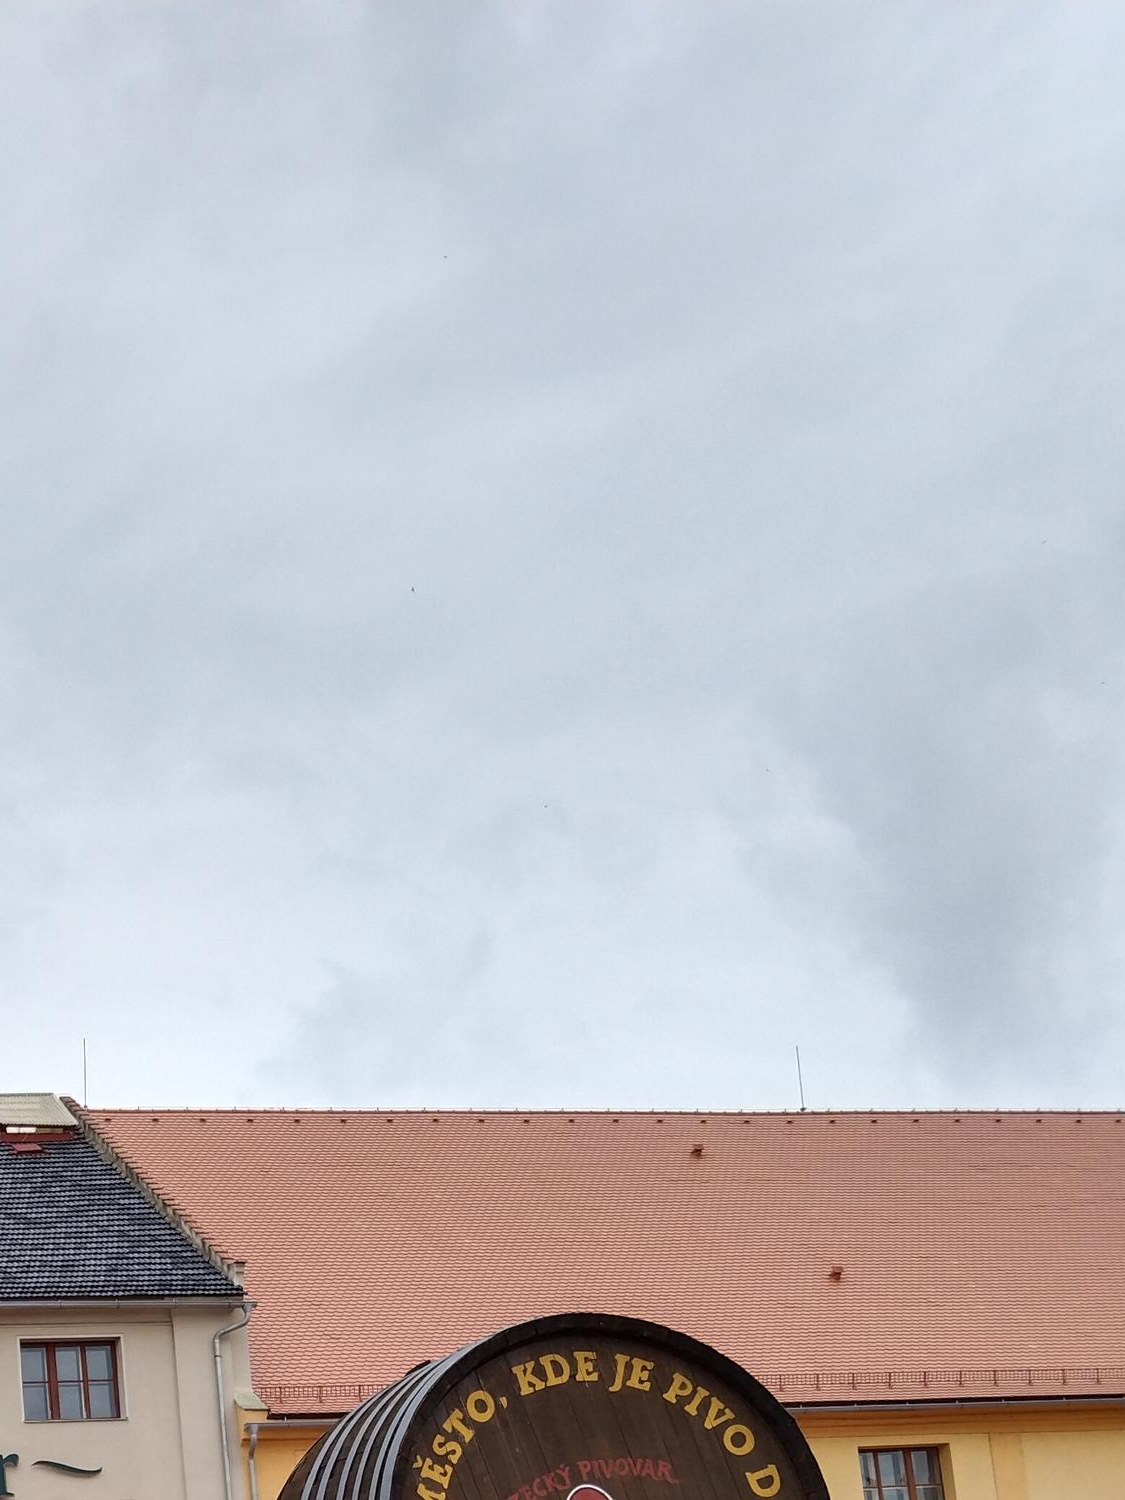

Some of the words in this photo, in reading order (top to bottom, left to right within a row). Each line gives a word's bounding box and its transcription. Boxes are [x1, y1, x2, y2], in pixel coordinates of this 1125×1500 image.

[511, 1351, 600, 1396] KDE
[608, 1353, 655, 1392] JE
[662, 1372, 756, 1456] PIVO
[577, 1457, 680, 1484] PIVOVAR
